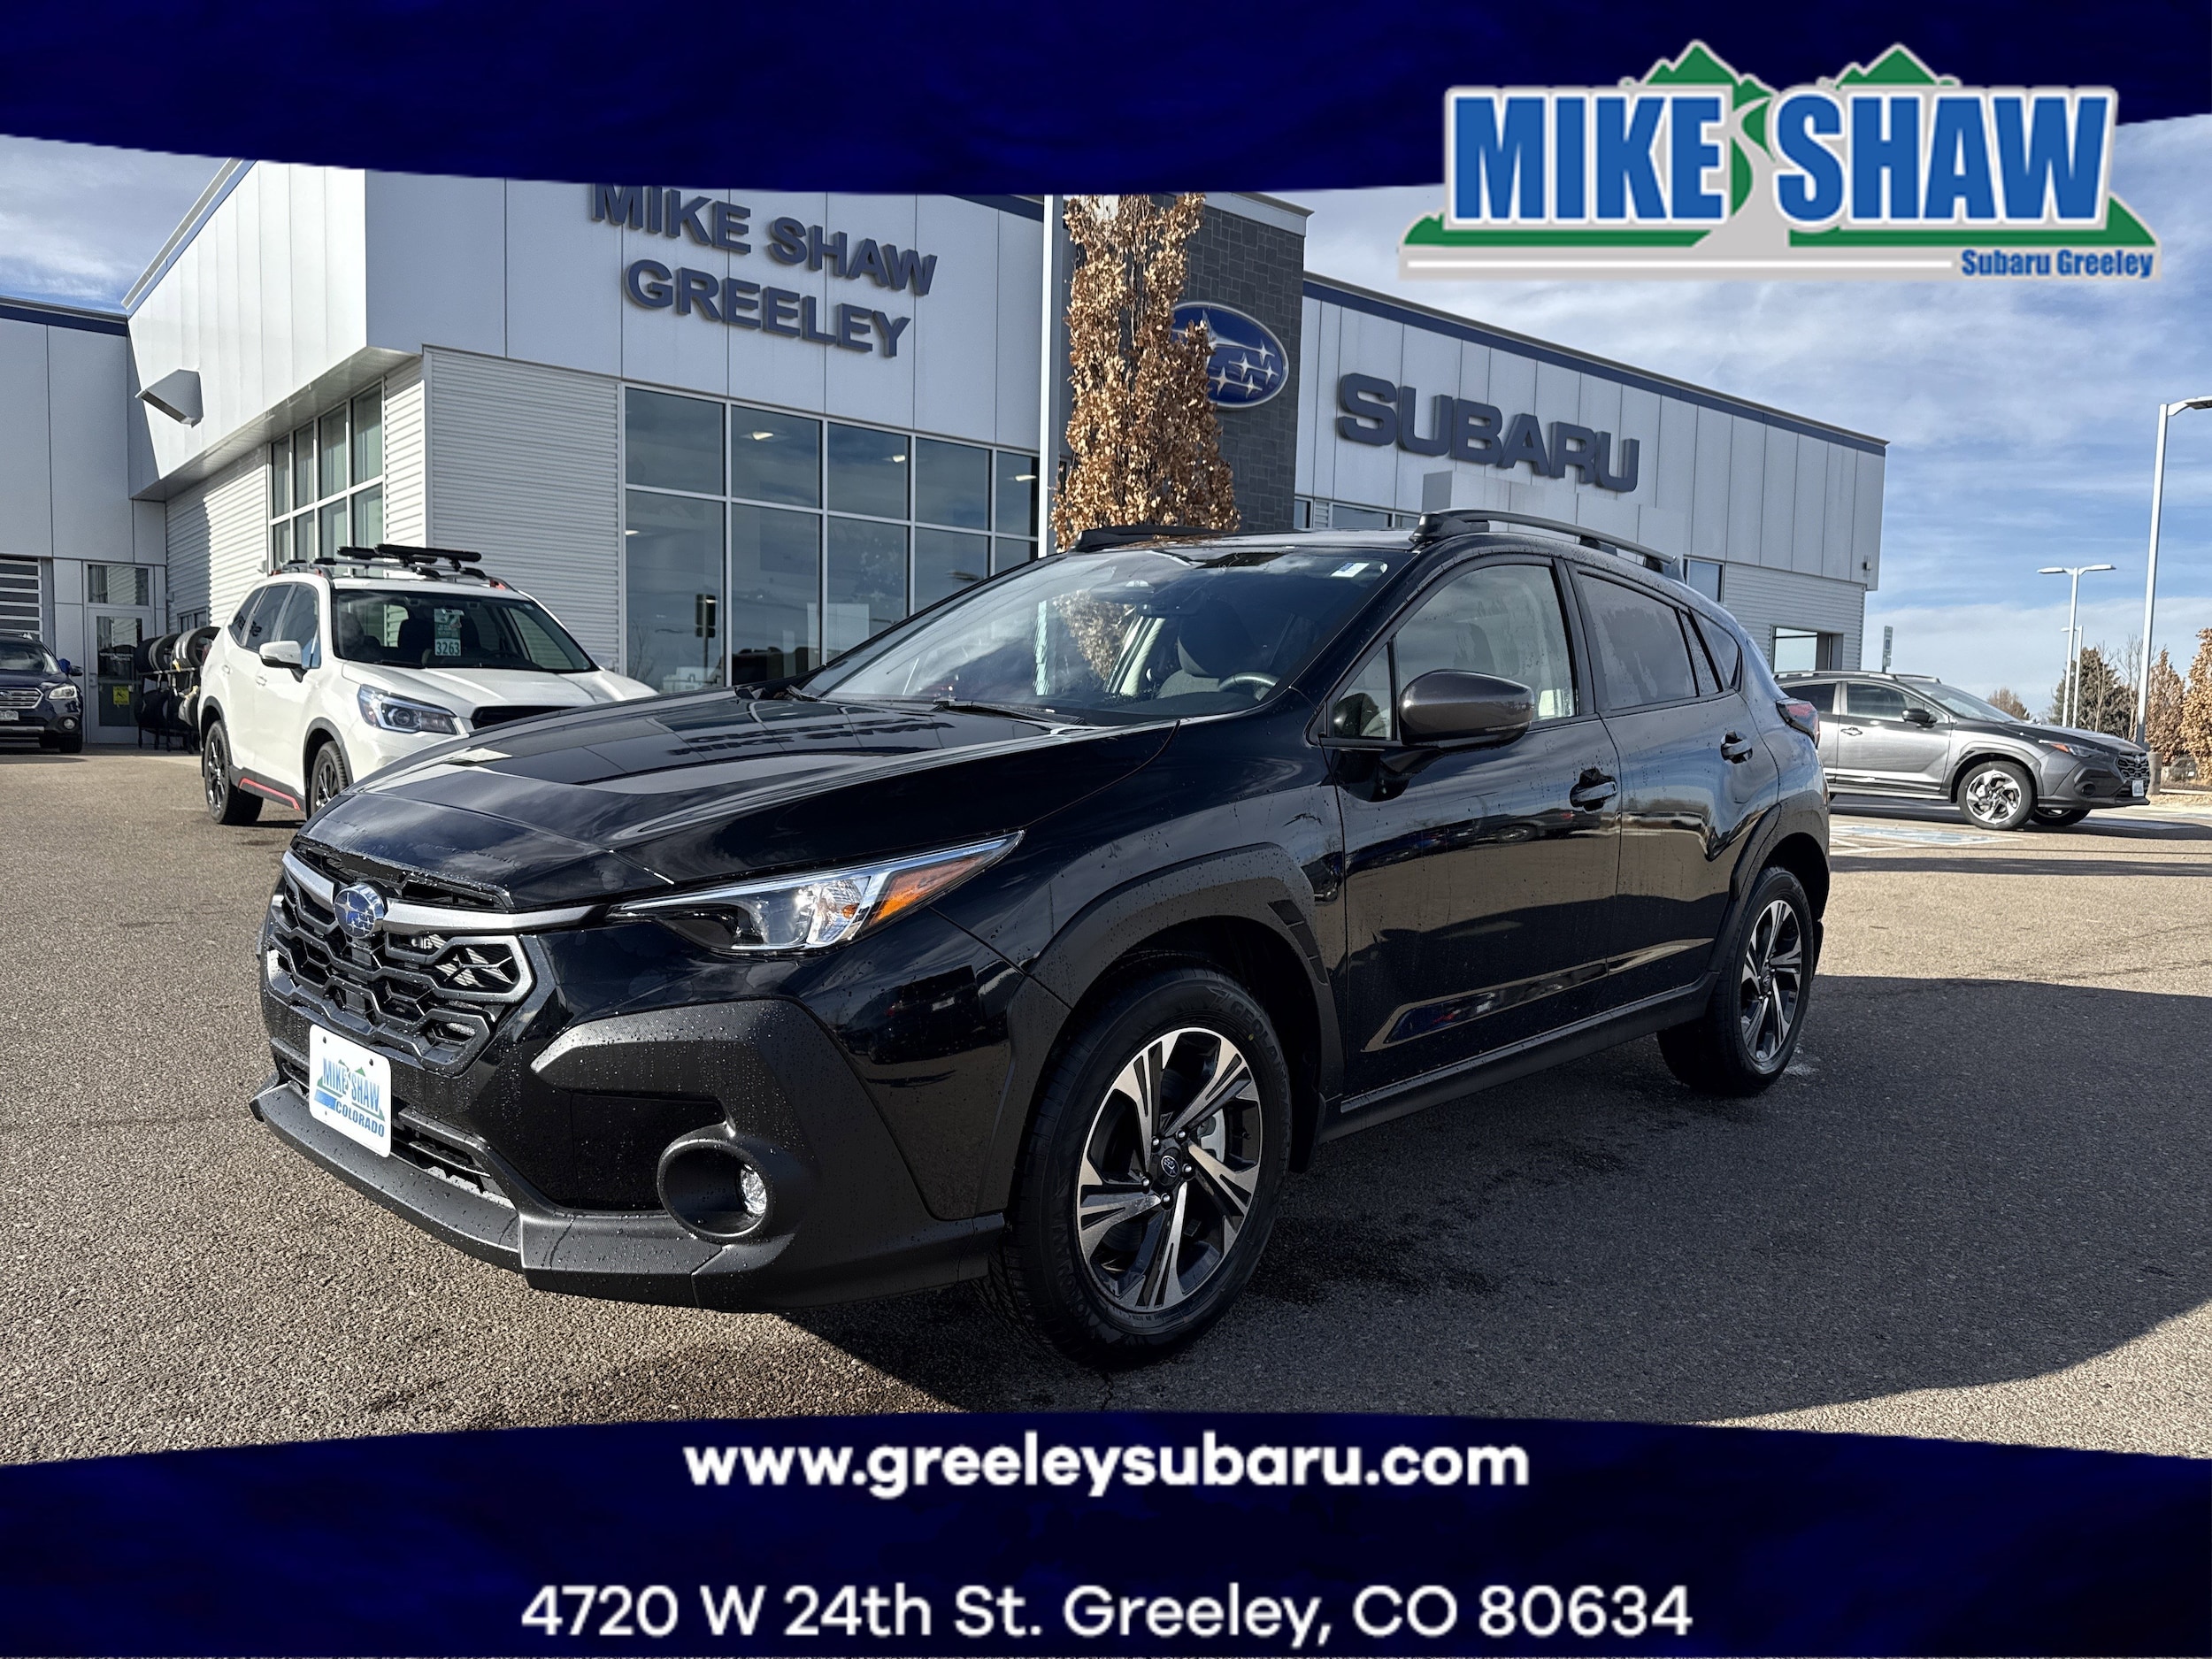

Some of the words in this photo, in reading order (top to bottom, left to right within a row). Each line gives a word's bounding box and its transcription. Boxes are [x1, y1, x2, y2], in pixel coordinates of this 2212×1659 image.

[591, 183, 751, 255] MIKE
[767, 216, 938, 296] SHAW
[625, 258, 911, 357] GREELEY
[1337, 372, 1640, 493] SUBARU
[436, 641, 460, 656] 3263
[322, 1056, 347, 1095] MIKE
[350, 1071, 380, 1113] SHAW
[335, 1100, 386, 1138] COLORADO
